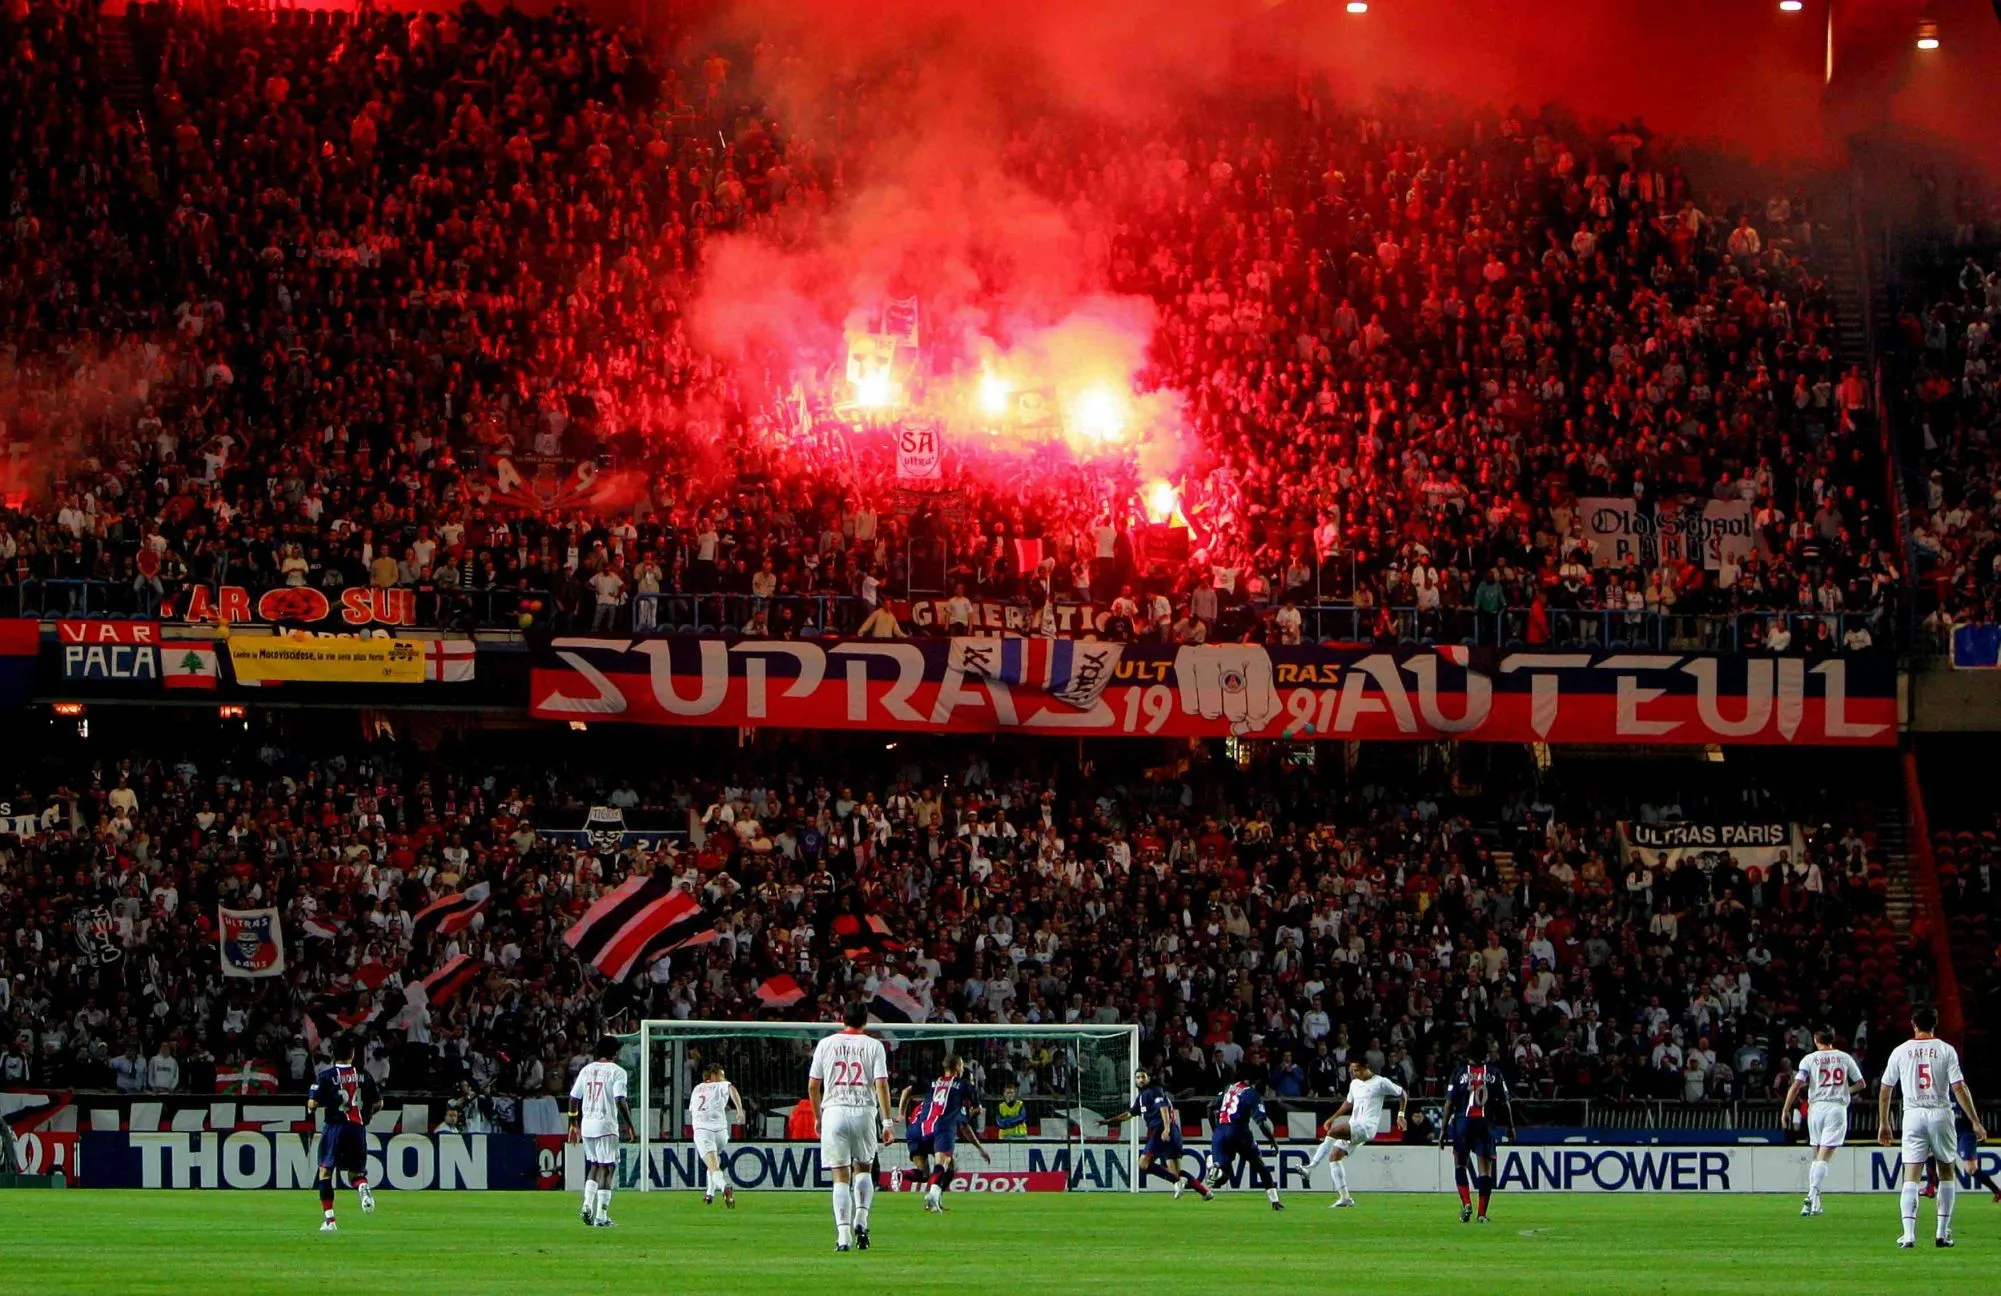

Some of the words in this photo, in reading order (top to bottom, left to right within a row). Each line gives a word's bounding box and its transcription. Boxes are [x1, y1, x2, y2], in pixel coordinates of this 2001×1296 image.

[901, 432, 933, 453] SA
[63, 623, 151, 642] VAR
[66, 646, 155, 678] PACA
[1276, 663, 1341, 683] RAS
[1123, 684, 1173, 735] 19
[1286, 687, 1337, 736] 91
[1635, 824, 1716, 845] ULTRAS
[1721, 823, 1784, 845] PARIS
[224, 917, 268, 928] ULTRAS
[835, 1061, 863, 1085] 22
[1819, 1068, 1844, 1087] 29
[1918, 1064, 1931, 1089] 5
[337, 1088, 363, 1112] 24
[586, 1081, 603, 1102] 17
[129, 1132, 487, 1190] THOMSON
